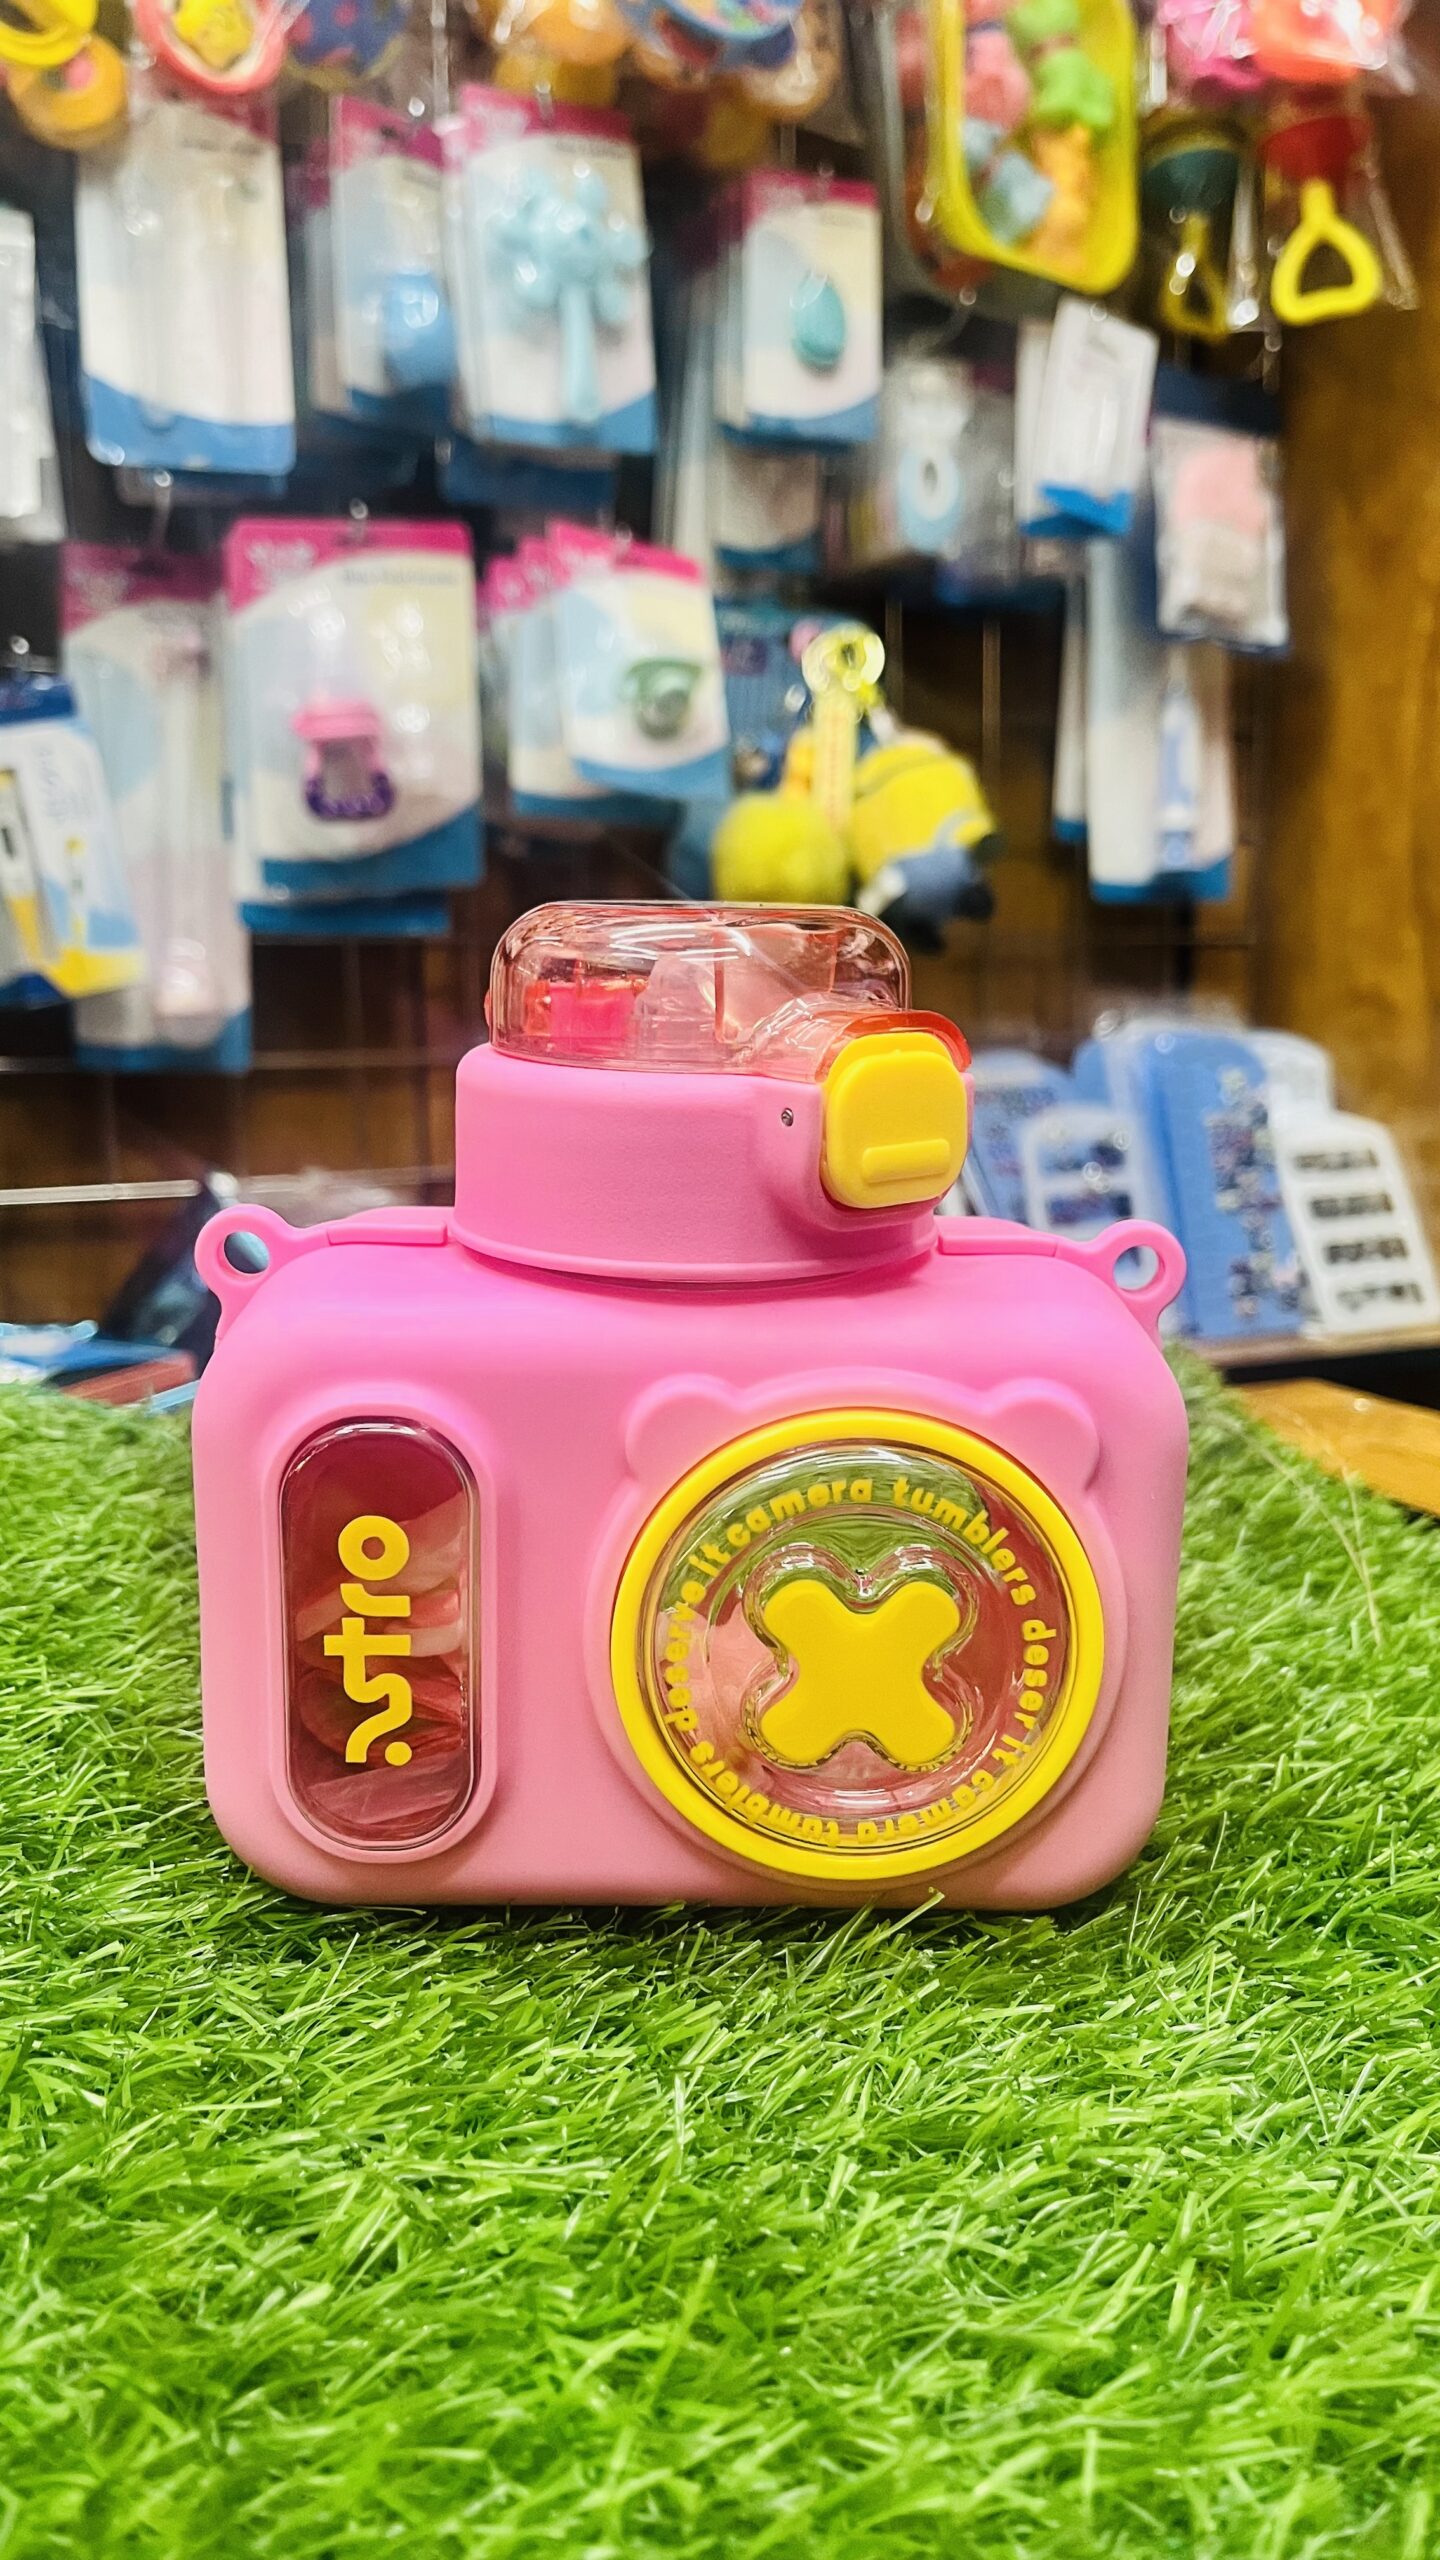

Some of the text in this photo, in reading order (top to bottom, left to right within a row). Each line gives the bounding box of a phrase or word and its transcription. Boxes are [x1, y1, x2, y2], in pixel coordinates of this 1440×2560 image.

[689, 1543, 732, 1579] it
[726, 1478, 873, 1547] camera
[892, 1476, 1036, 1606] tumblers
[690, 1740, 840, 1848] tumblers
[992, 1734, 1032, 1766] it
[857, 1769, 995, 1843] camera
